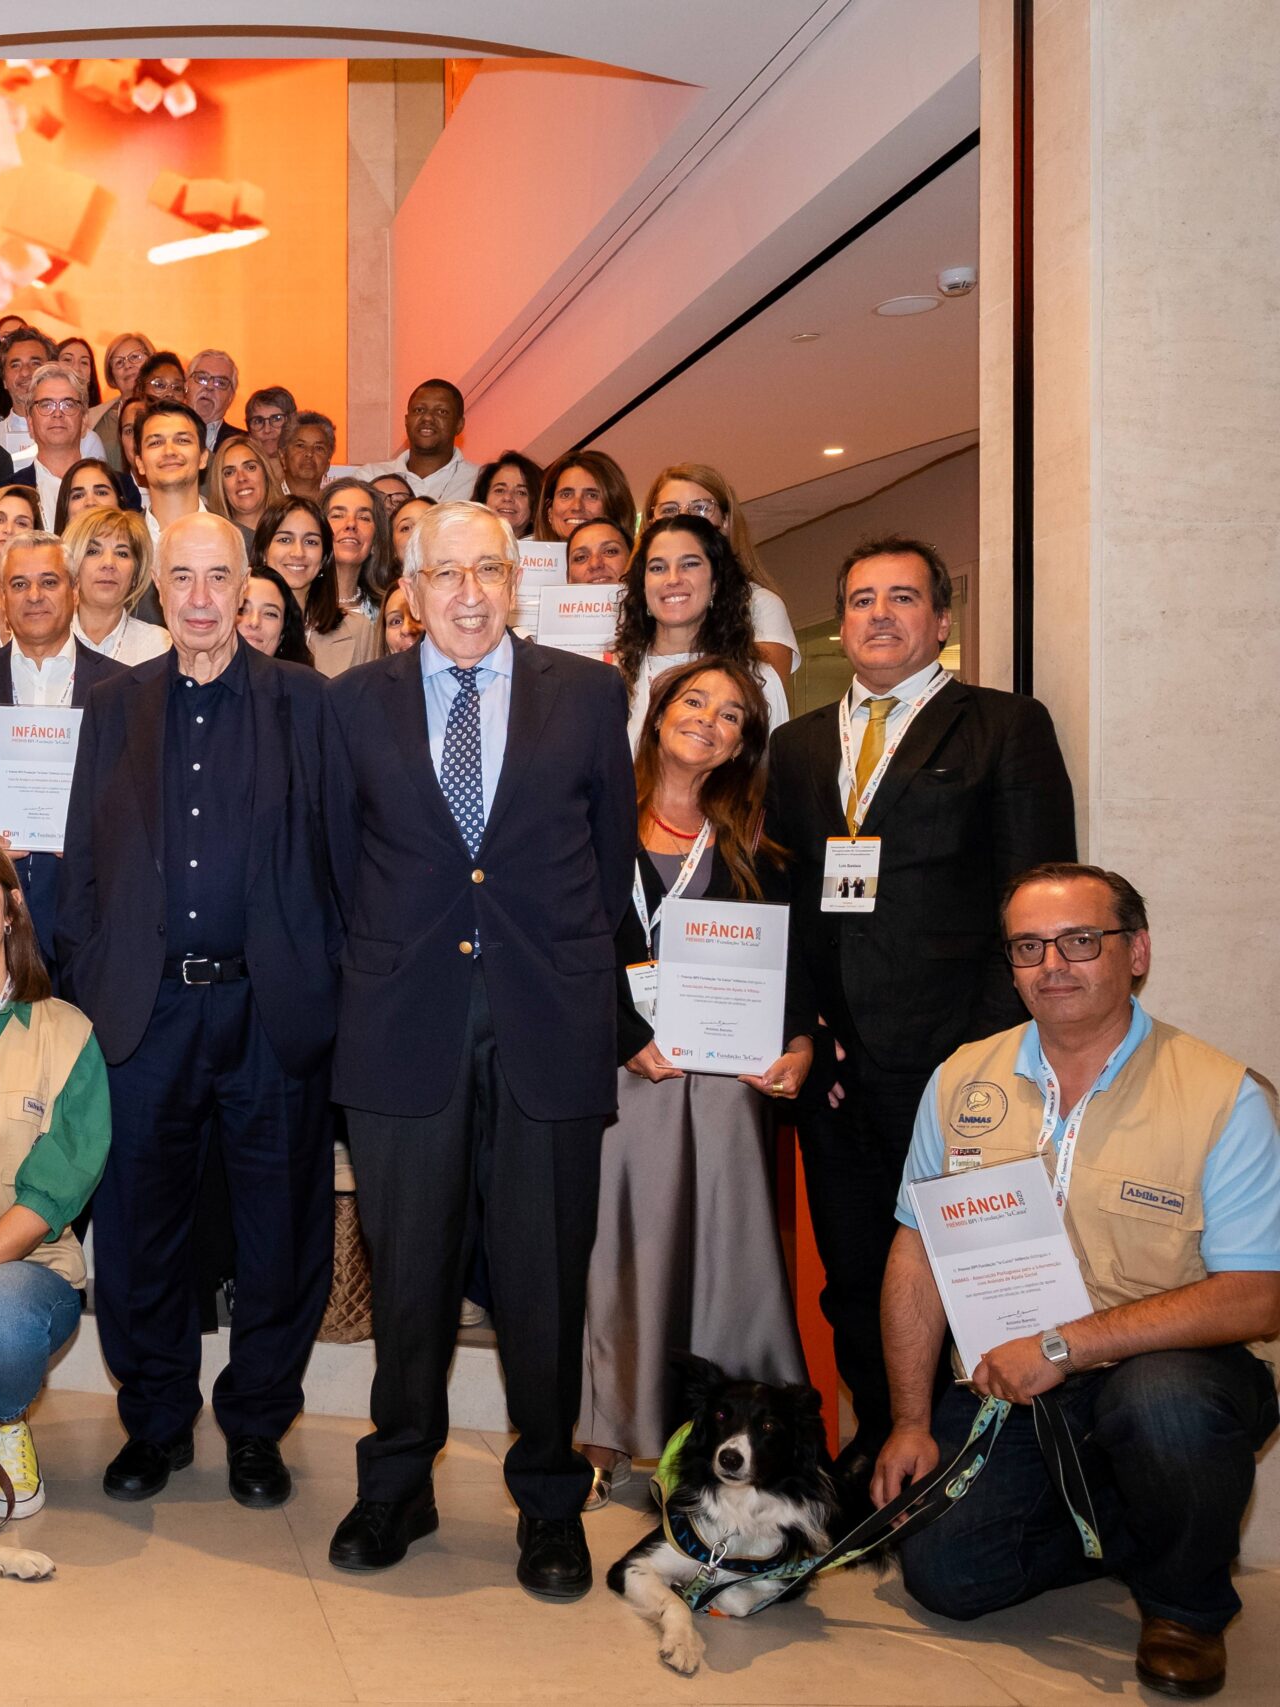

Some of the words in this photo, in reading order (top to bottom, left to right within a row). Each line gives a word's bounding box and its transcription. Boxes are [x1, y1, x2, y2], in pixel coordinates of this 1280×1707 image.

[520, 556, 554, 567] FÂNCIA
[559, 601, 613, 613] INFÂNCIA
[12, 724, 65, 738] INFÂNCIA
[686, 921, 754, 940] INFÂNCIA
[682, 1048, 693, 1056] BPI
[958, 1114, 992, 1123] ÂNIMAS
[941, 1192, 1018, 1221] INFÂNCIA
[946, 1220, 967, 1228] PRÉMIOS
